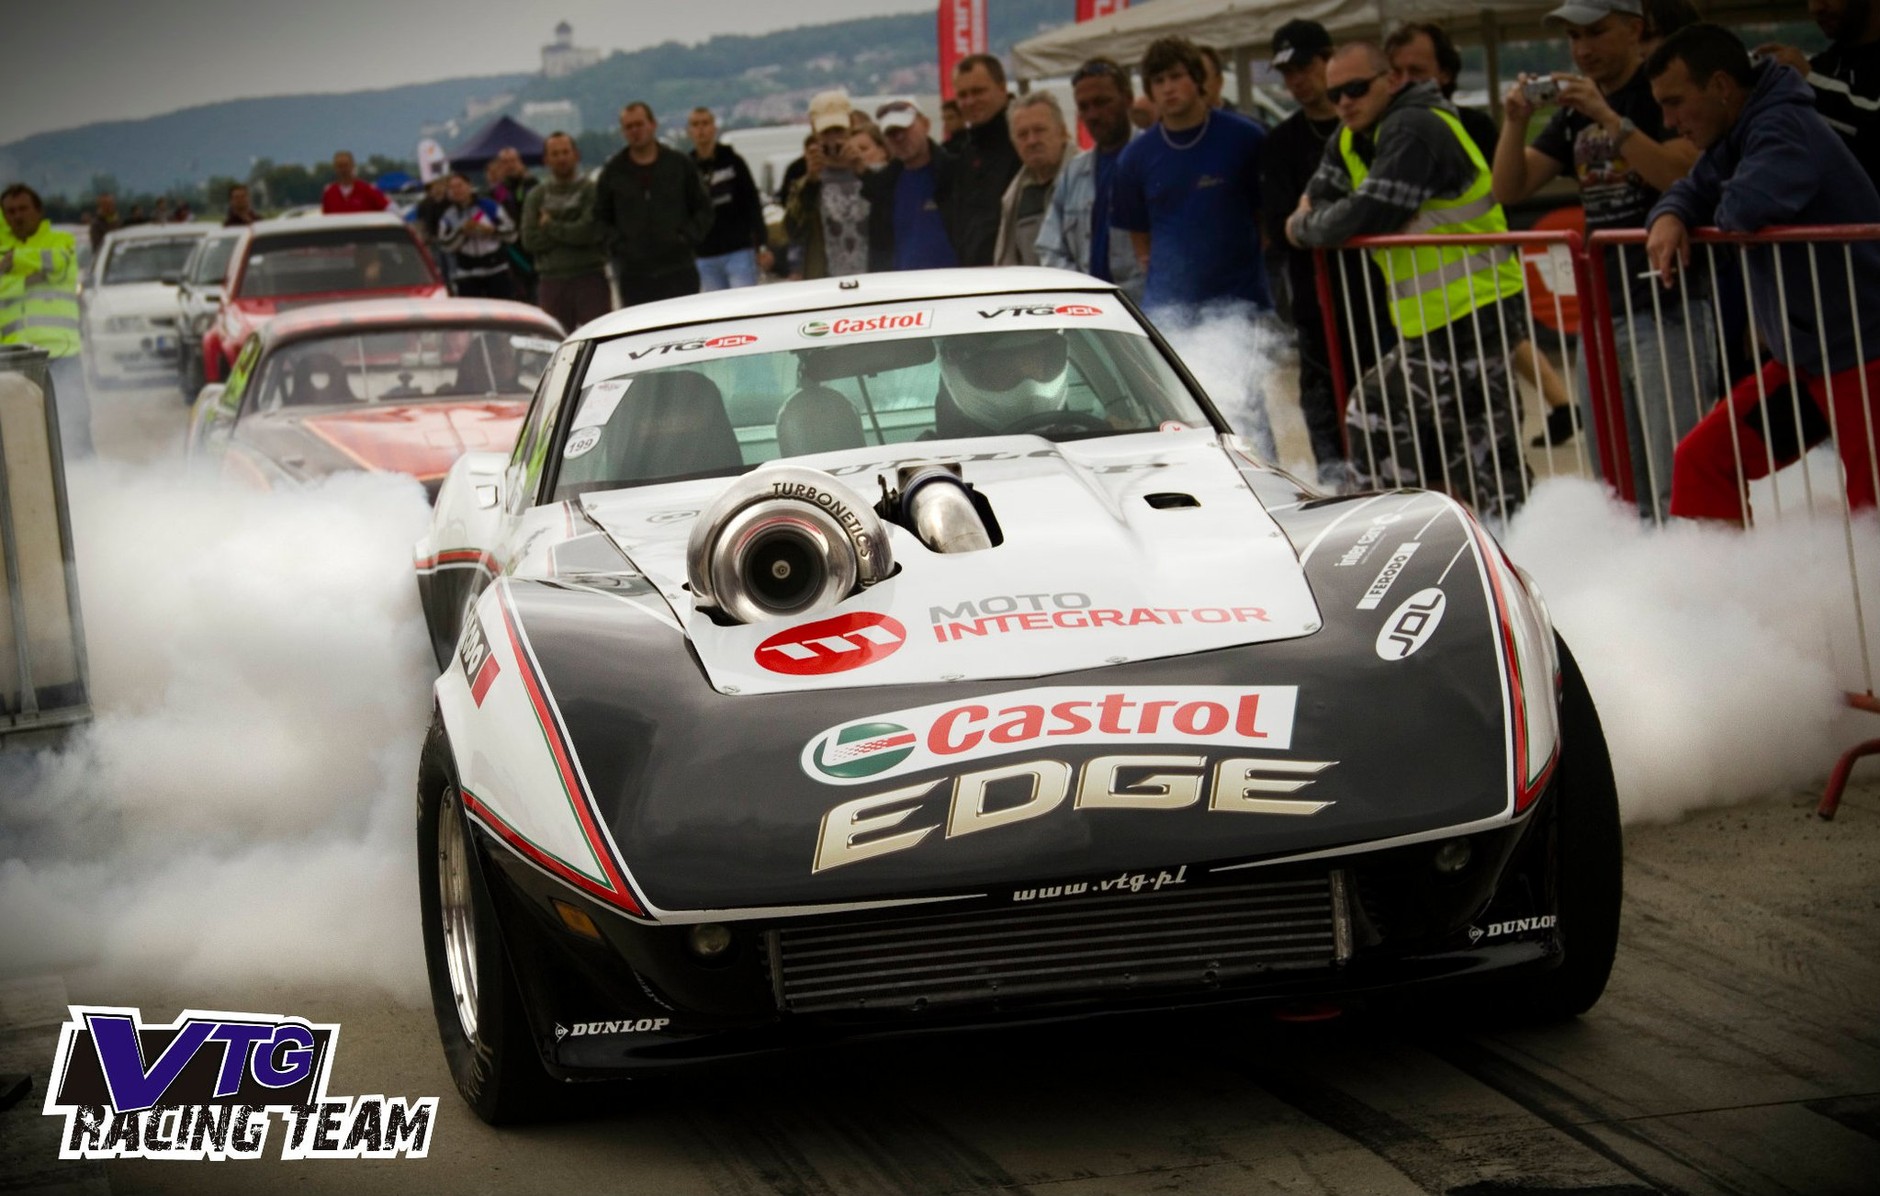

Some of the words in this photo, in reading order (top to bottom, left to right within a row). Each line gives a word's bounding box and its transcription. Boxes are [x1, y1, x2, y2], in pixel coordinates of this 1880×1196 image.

[832, 311, 925, 335] Castrol
[976, 306, 1056, 319] VTG
[628, 340, 706, 361] VTG
[569, 438, 594, 454] 199
[772, 481, 873, 561] TURBONETICS
[1369, 554, 1408, 596] FERODO
[929, 591, 1092, 624] MOTO
[933, 606, 1273, 643] INTEGRATOR
[1388, 593, 1443, 657] JDL
[926, 693, 1269, 756] Castrol
[811, 755, 1341, 875] EDGE
[1012, 865, 1188, 902] www.vtg.pl
[570, 1017, 670, 1037] DUNLOP
